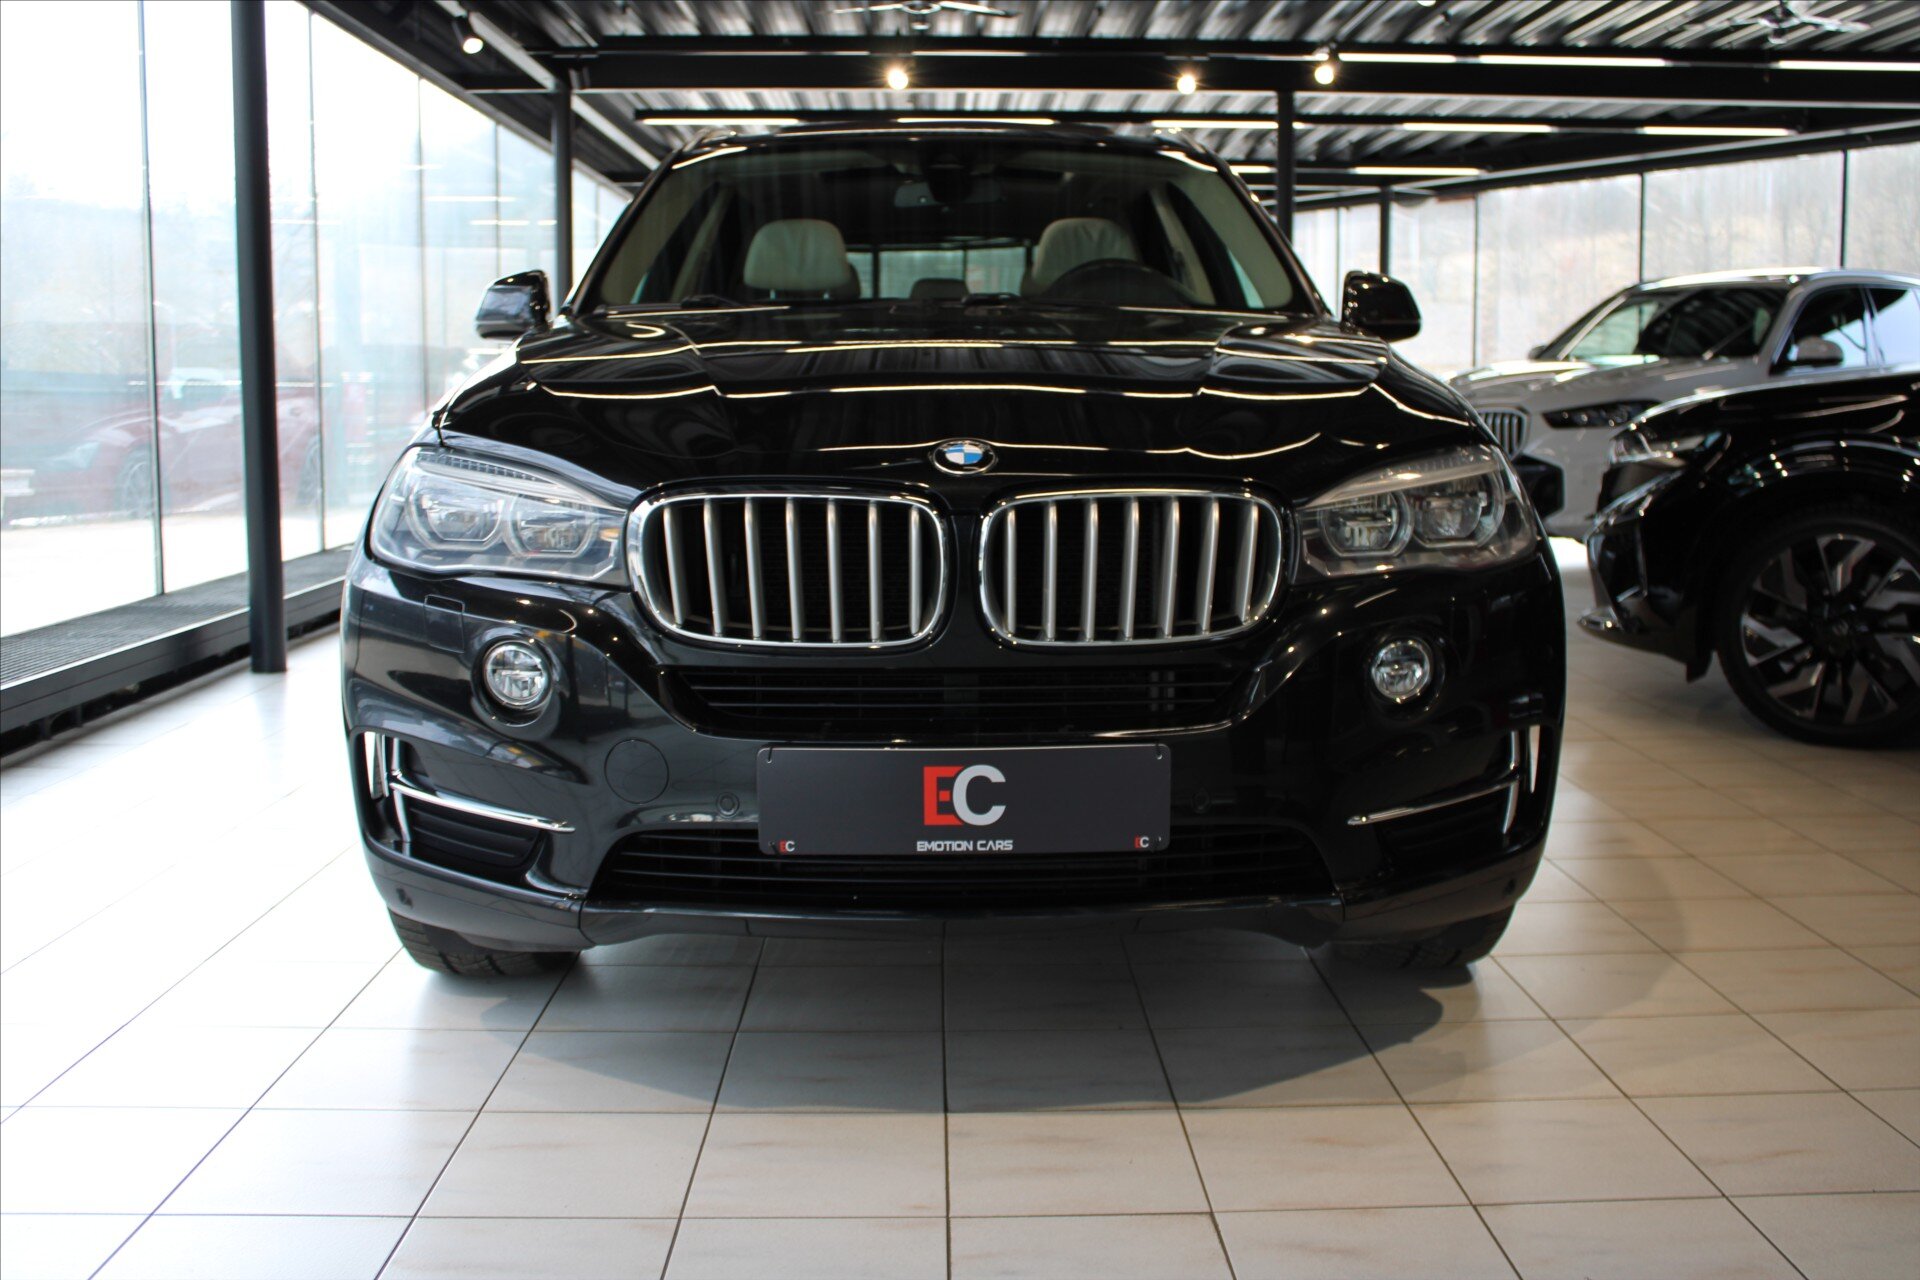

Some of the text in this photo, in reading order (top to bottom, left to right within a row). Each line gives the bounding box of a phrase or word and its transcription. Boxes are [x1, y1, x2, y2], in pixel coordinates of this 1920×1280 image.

[924, 765, 1006, 825] EC
[917, 840, 1013, 851] EMOTION CARS
